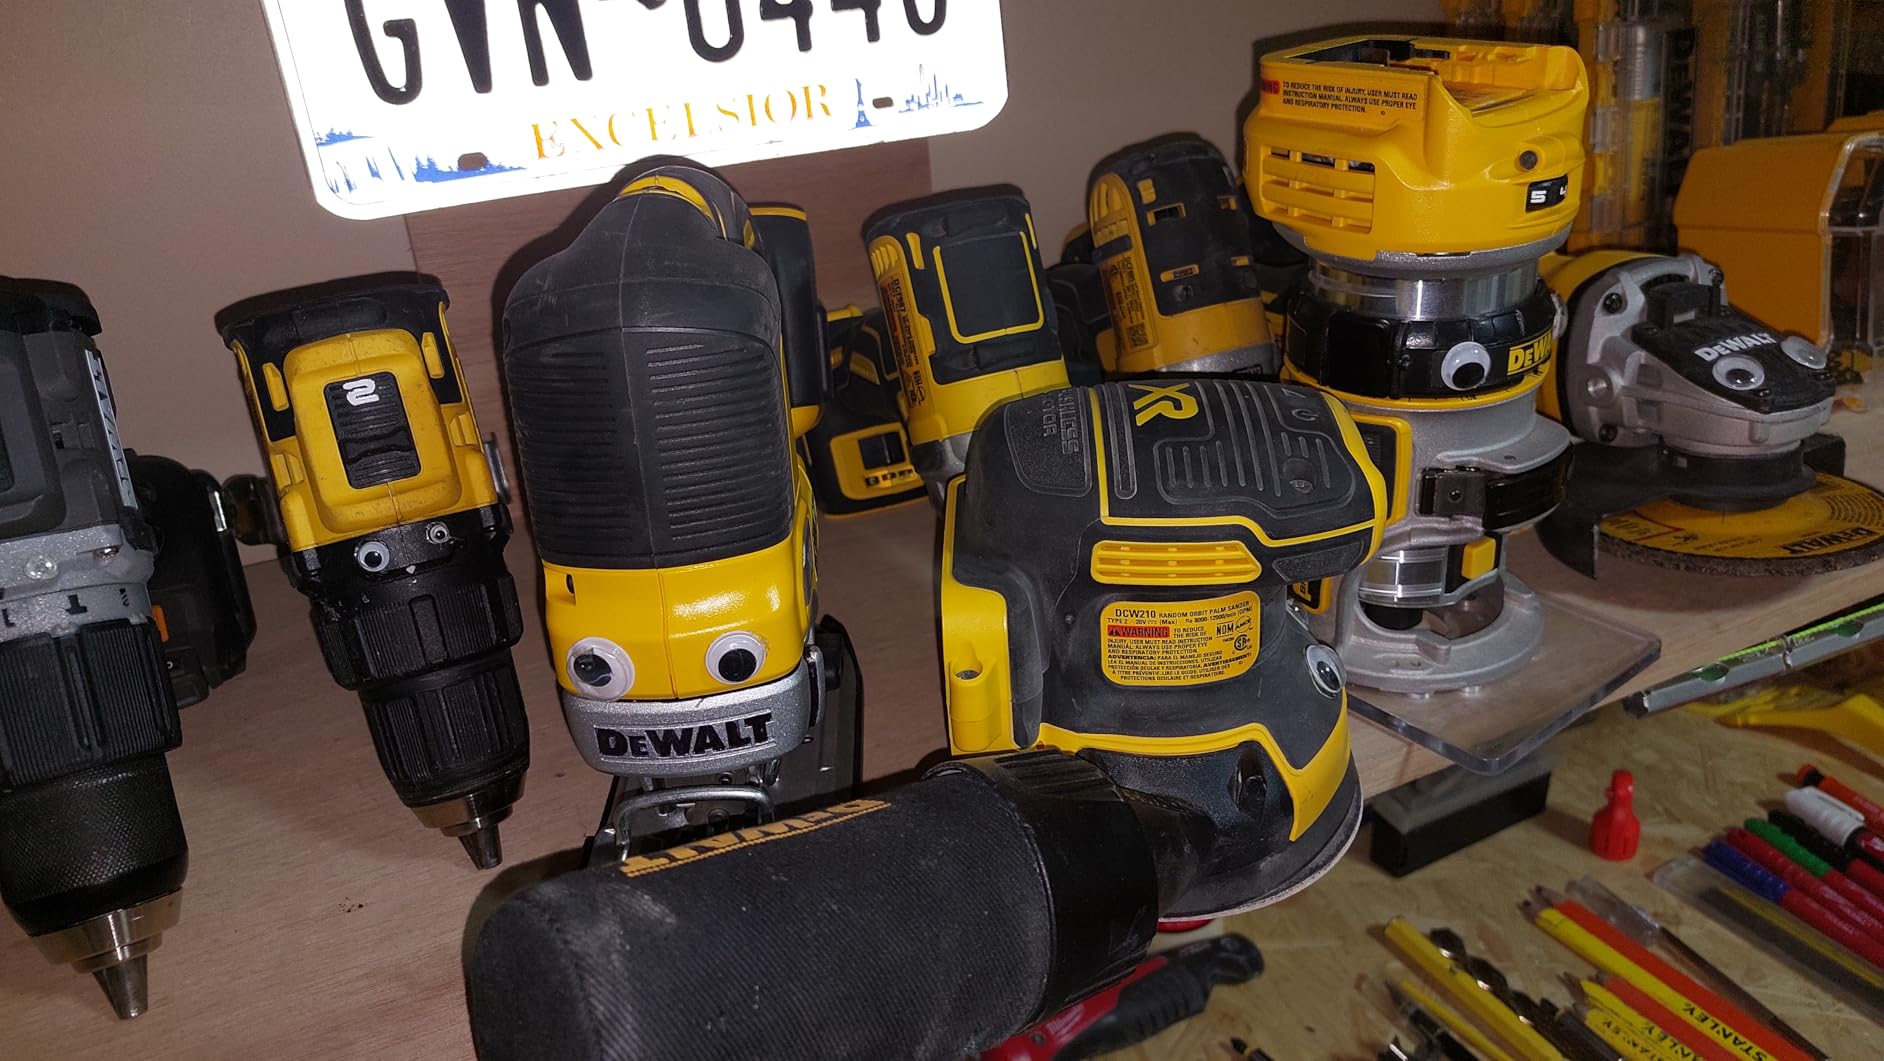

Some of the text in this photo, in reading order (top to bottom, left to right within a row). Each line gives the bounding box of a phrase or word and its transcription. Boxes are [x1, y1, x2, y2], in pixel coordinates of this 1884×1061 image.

[1283, 81, 1290, 89] TO
[1291, 82, 1310, 90] REDUCE
[1312, 83, 1322, 91] THE
[1323, 85, 1336, 93] RISK
[1367, 89, 1382, 97] USER
[1384, 91, 1400, 99] MUST
[1402, 92, 1418, 101] READ
[1283, 90, 1317, 98] INSTRUCTION
[1345, 95, 1367, 104] ALWAYS
[1369, 98, 1380, 106] USE
[1381, 99, 1404, 108] PROPER
[1406, 102, 1417, 110] EYE
[1295, 99, 1329, 109] RESPIRATORY
[532, 84, 832, 160] EXCELSIOR
[1530, 190, 1546, 204] 5
[1128, 382, 1199, 427] XR
[1115, 600, 1250, 619] DCW210 RANDOM ORBIT PALM SANDER
[1121, 626, 1169, 637] WARNING
[1216, 622, 1234, 637] NOM
[1177, 636, 1213, 644] INSTRUCTION
[595, 713, 773, 757] DEWALT
[1683, 1003, 1767, 1061] STANLEY
